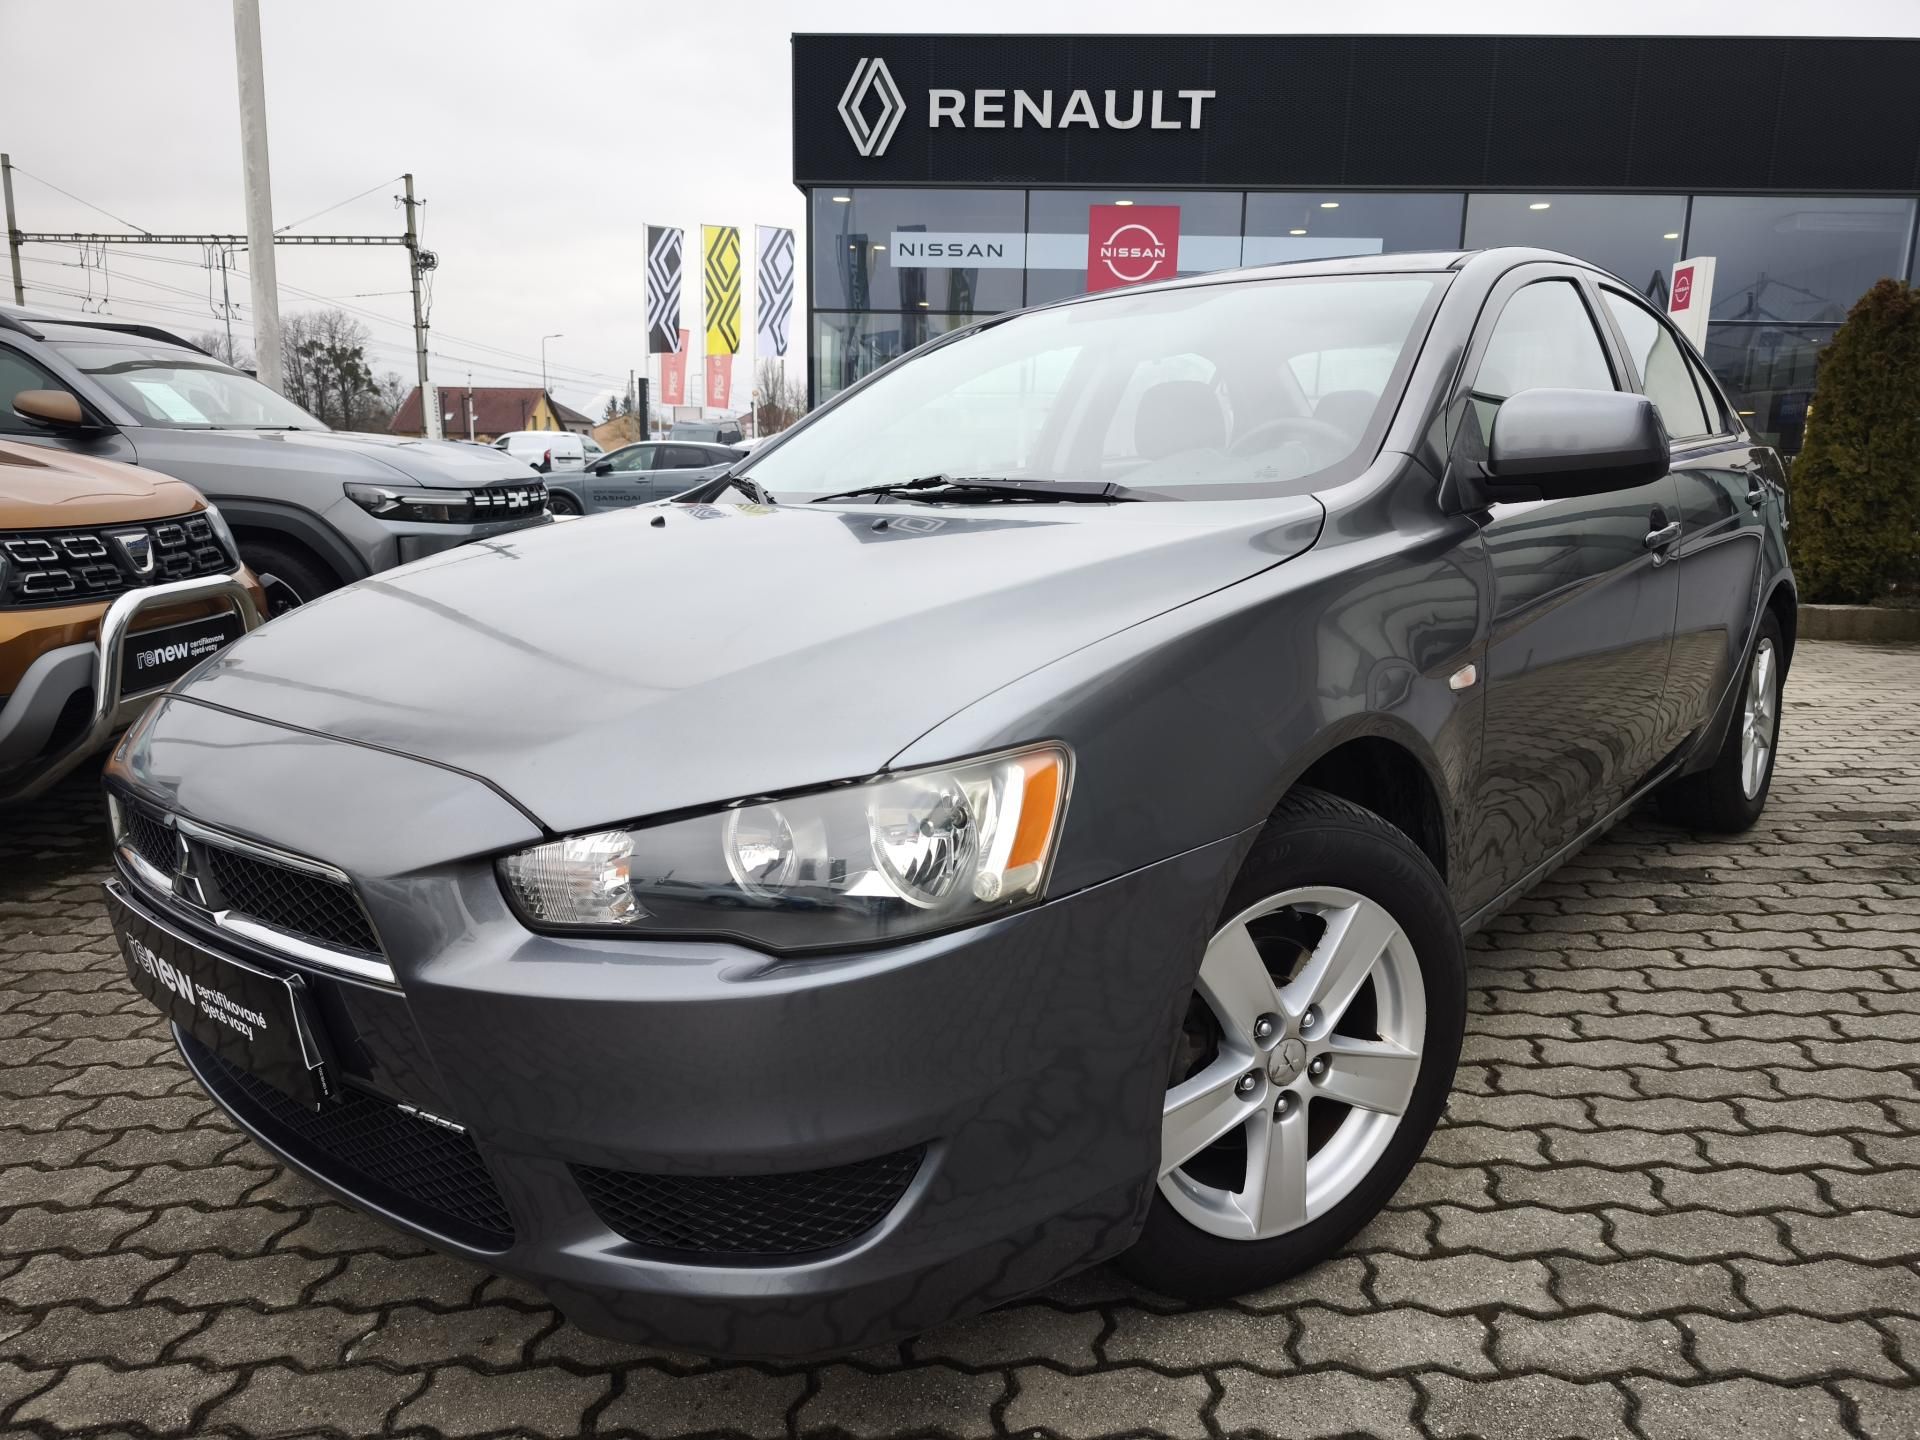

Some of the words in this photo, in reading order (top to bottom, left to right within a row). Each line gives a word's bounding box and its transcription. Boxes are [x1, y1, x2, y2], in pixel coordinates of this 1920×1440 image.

[928, 89, 1217, 130] RENAULT
[899, 243, 1005, 258] NISSAN
[1100, 247, 1166, 258] NISSAN
[136, 641, 189, 670] renew
[126, 932, 196, 1006] renew
[195, 983, 267, 1029] certifikované
[201, 1000, 228, 1025] ojeté
[227, 1014, 254, 1042] vozy
